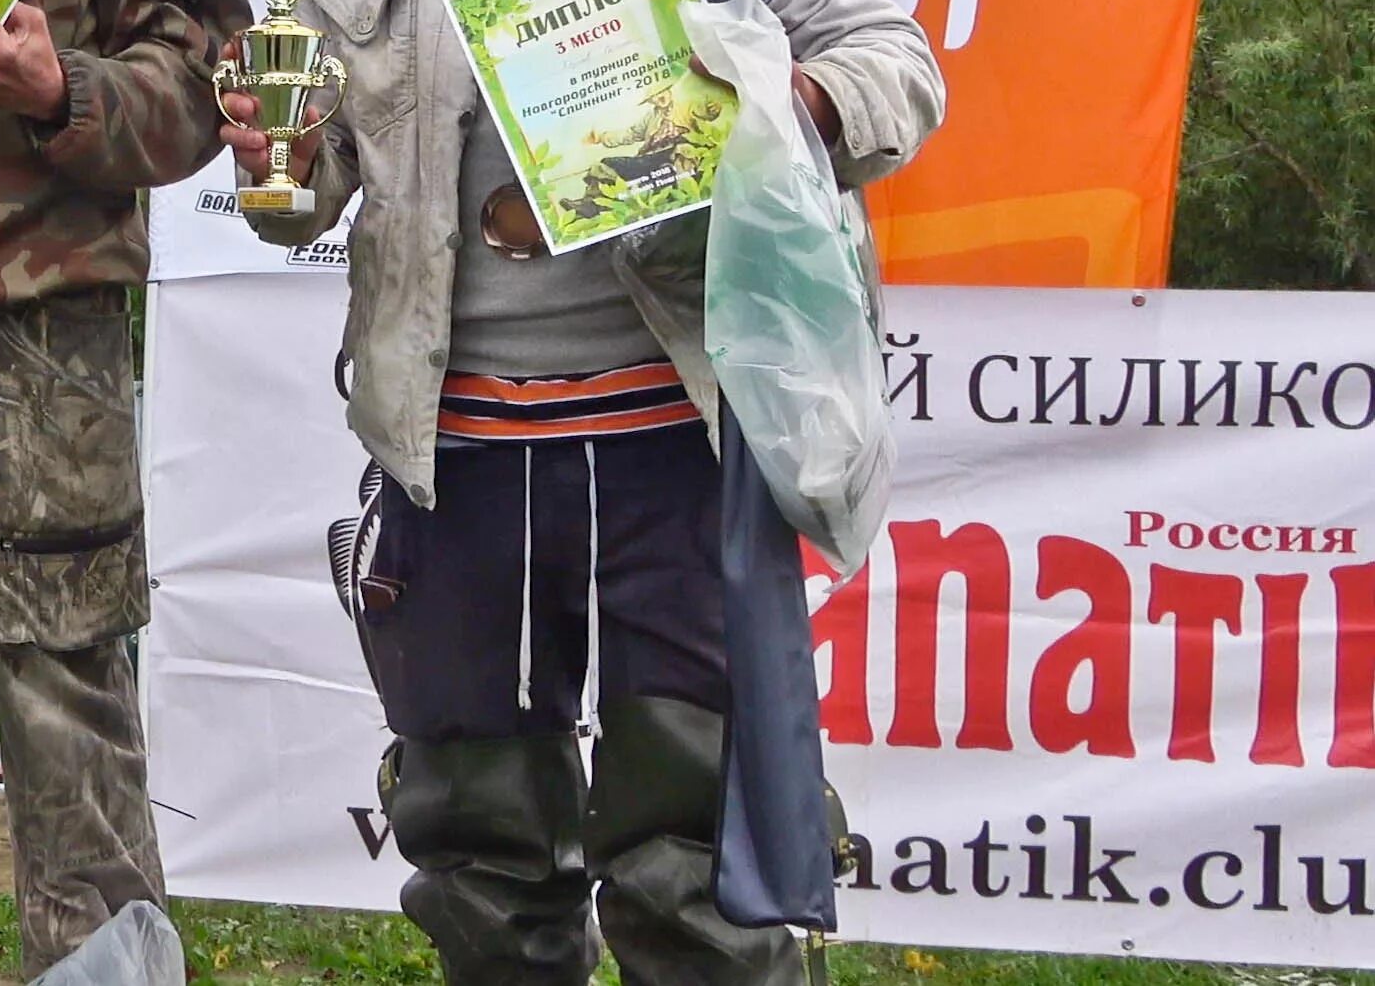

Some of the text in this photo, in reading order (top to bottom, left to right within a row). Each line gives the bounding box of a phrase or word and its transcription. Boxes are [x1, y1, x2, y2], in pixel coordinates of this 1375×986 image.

[555, 18, 622, 55] 3 МЕСТО
[569, 51, 640, 86] в турнире
[521, 75, 618, 118] Новгородские
[1124, 510, 1357, 554] Россия
